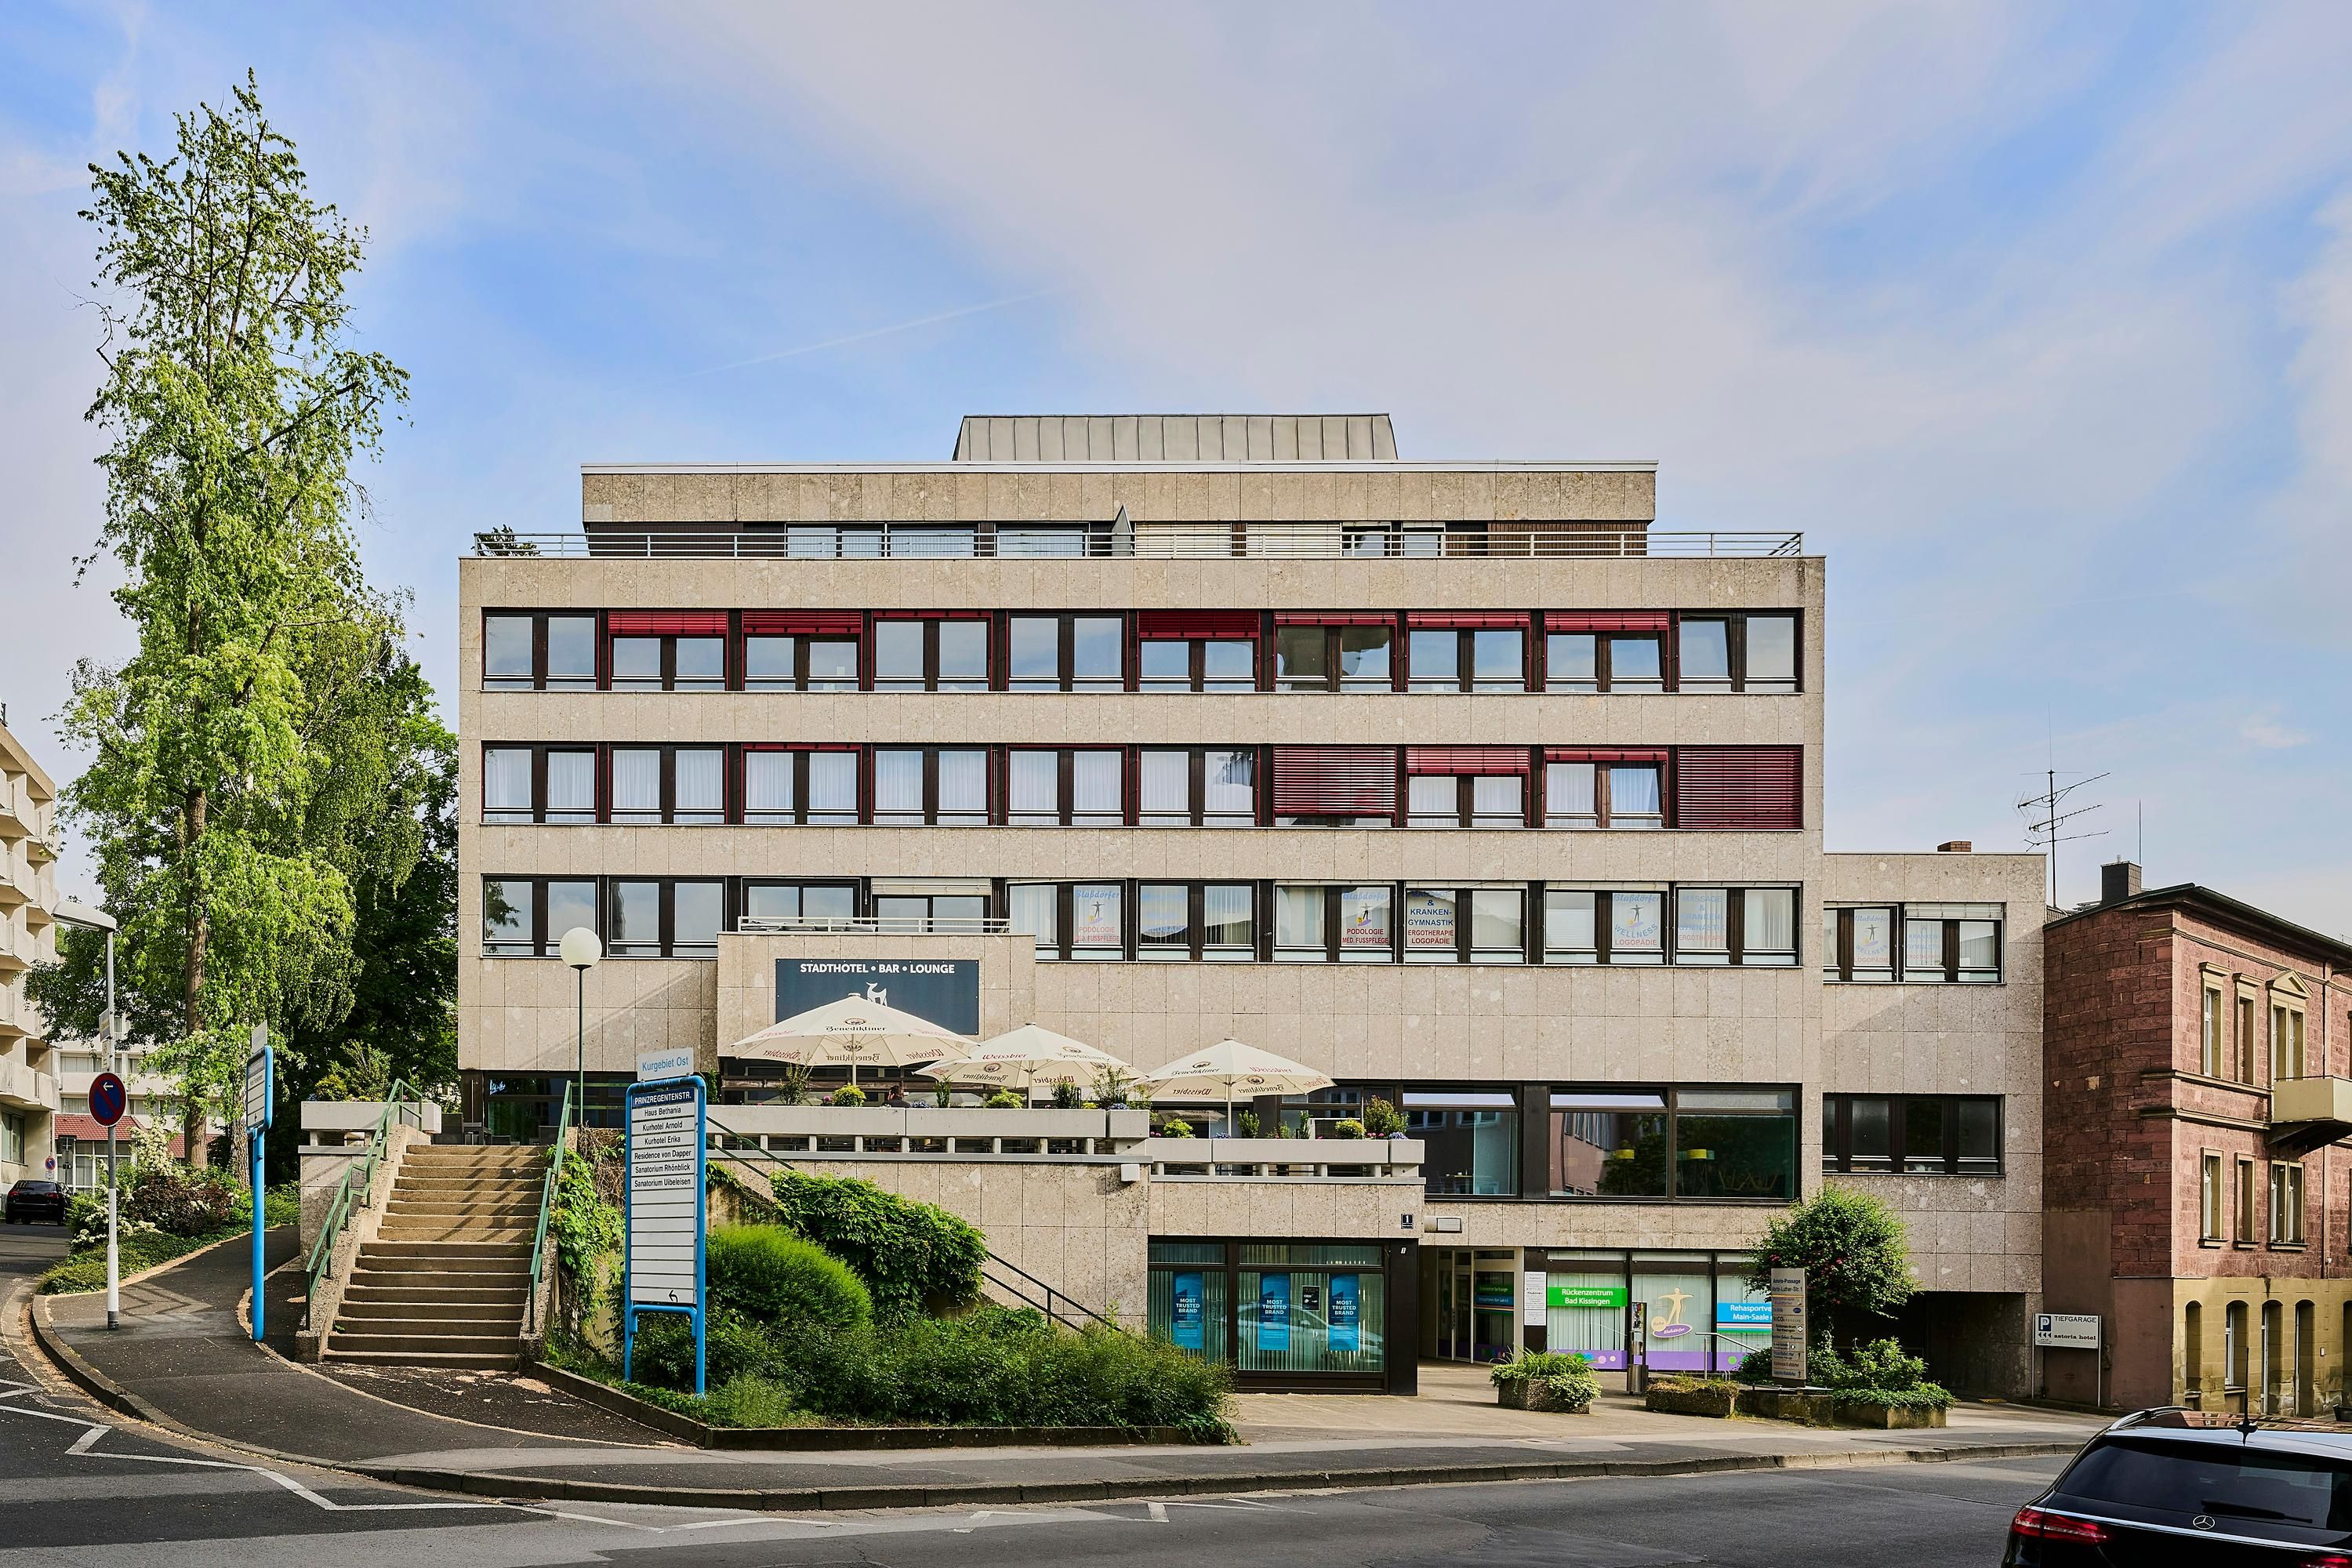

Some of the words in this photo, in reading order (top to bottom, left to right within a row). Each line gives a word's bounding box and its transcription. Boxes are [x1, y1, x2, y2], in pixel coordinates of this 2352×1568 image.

[1614, 924, 1657, 938] WELLNESS
[800, 964, 869, 973] STADTHOTEL
[878, 964, 900, 973] BAR
[909, 964, 955, 974] LOUNGE
[642, 1058, 674, 1072] Kurgebiet
[677, 1056, 688, 1066] Ost
[634, 1091, 691, 1105] PRINZREGENTENSTR.
[659, 1106, 681, 1115] Bethania
[642, 1123, 664, 1131] Kurhotel
[666, 1120, 683, 1129] Arnold
[644, 1136, 666, 1145] Kurhotel
[635, 1165, 663, 1174] Sanatorium
[1579, 1298, 1610, 1306] Kissingen
[2040, 1317, 2049, 1330] P
